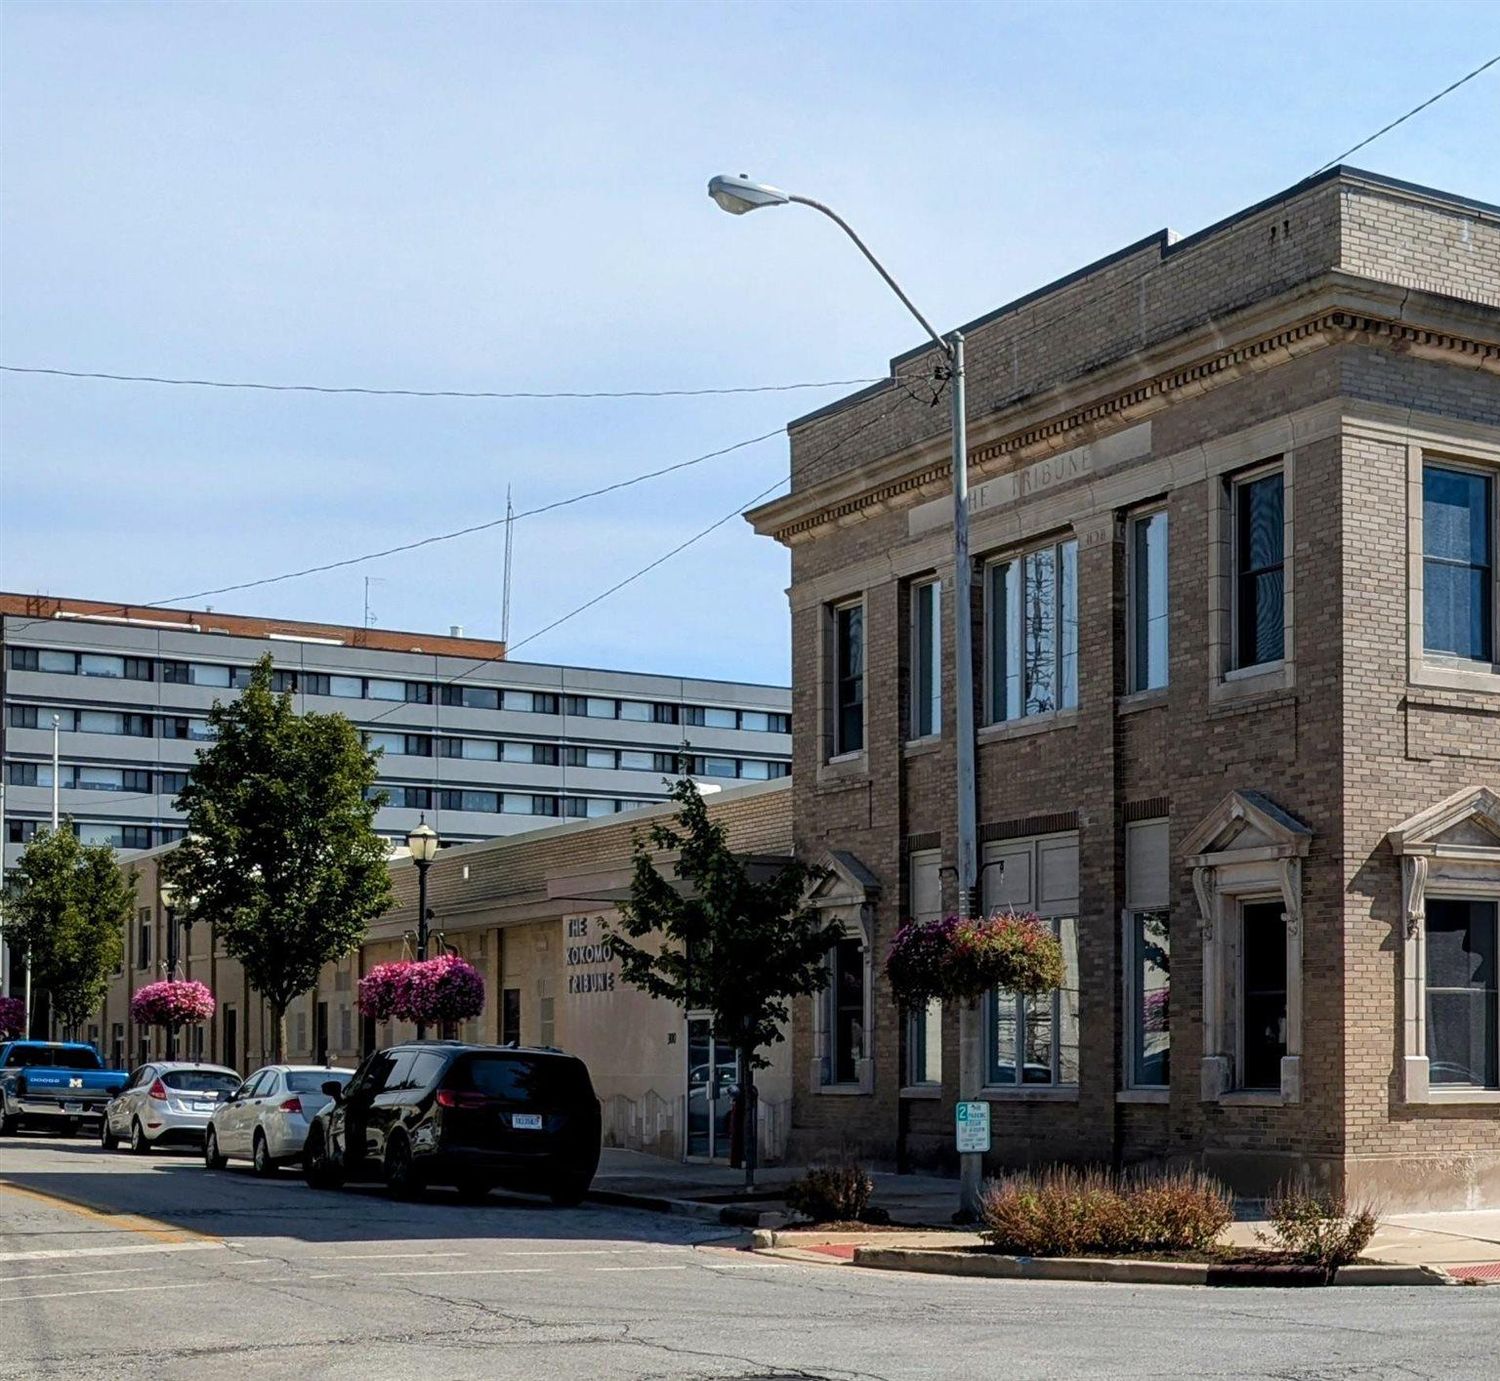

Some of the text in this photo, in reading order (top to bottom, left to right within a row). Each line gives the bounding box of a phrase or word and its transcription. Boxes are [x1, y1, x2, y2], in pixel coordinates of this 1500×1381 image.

[1008, 448, 1092, 497] TRIBUNE
[568, 917, 588, 938] THE
[566, 944, 614, 966] KOKOMO
[568, 972, 615, 994] TRIBUNE
[69, 1077, 83, 1088] M
[959, 1106, 967, 1119] 2
